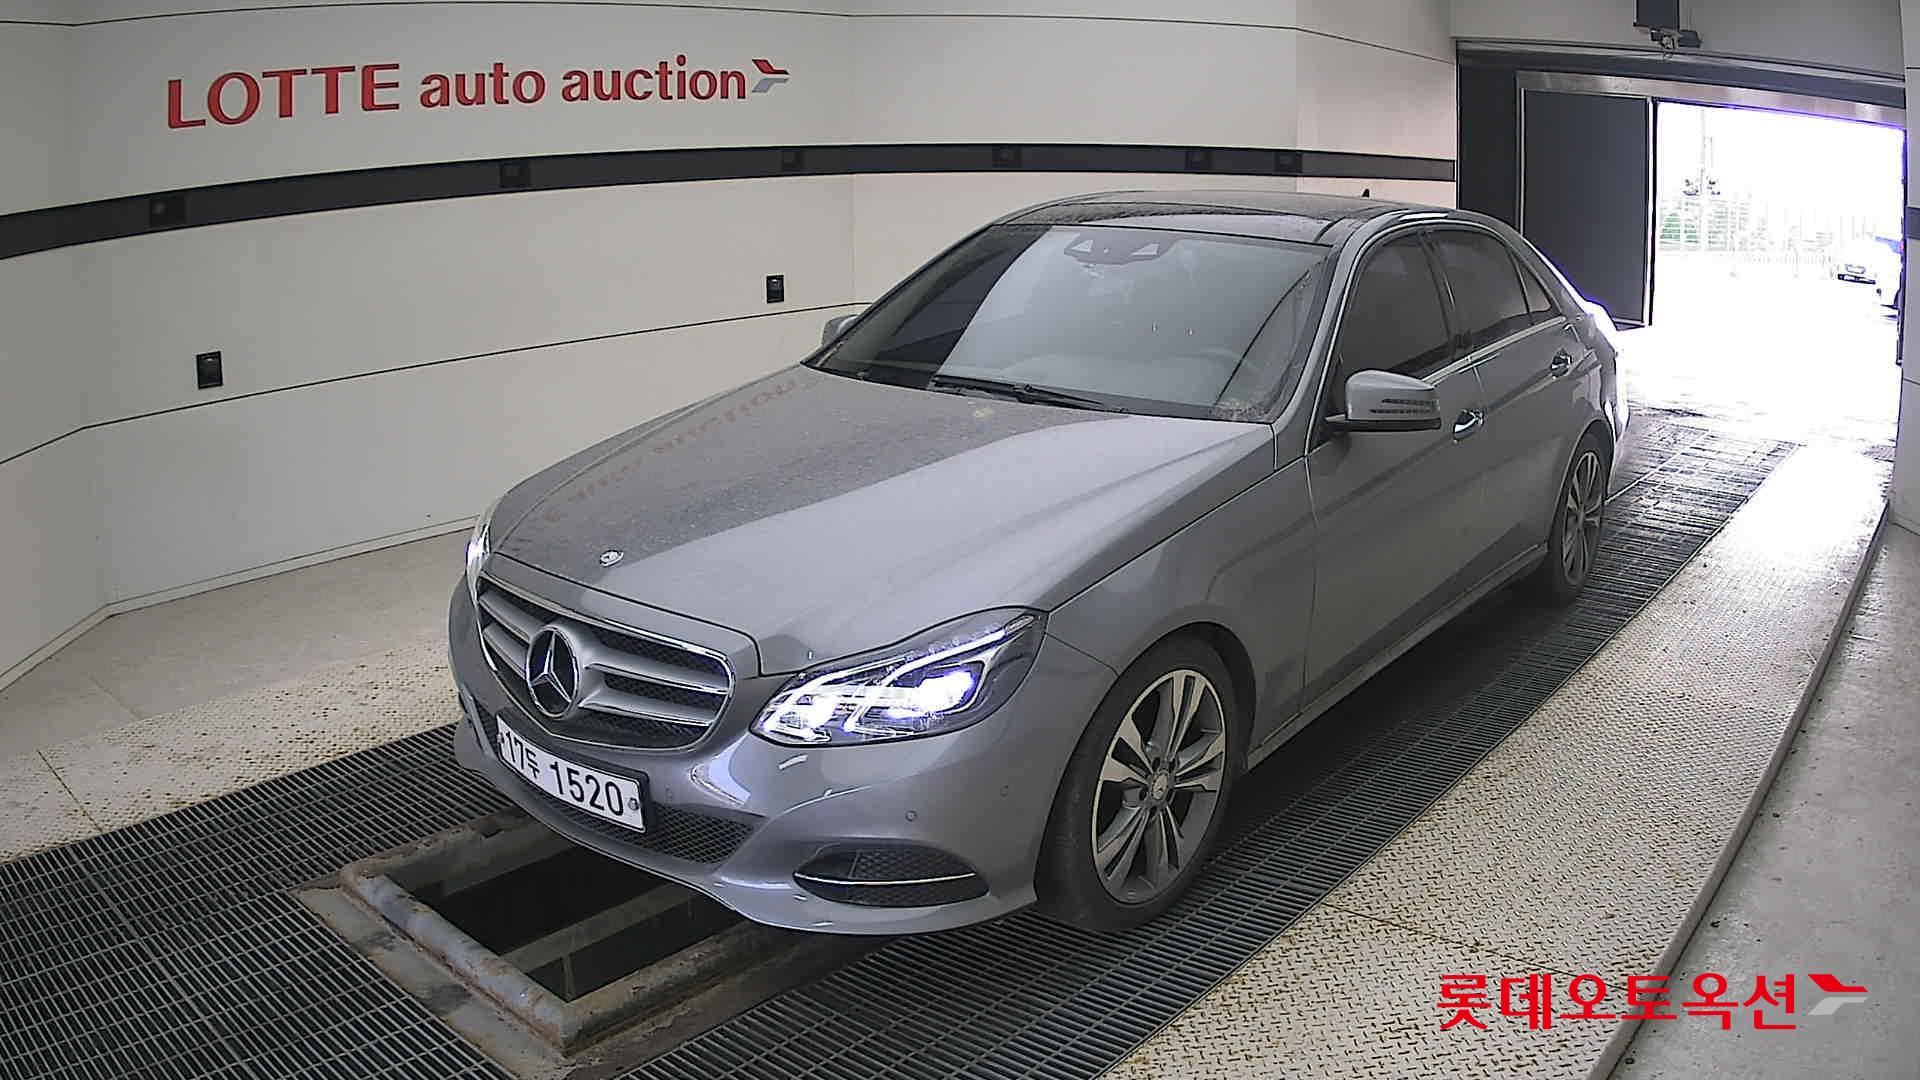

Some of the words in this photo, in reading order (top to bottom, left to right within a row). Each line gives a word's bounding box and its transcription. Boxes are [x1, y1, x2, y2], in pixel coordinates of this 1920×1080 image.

[167, 63, 400, 129] LOTTE
[419, 62, 546, 108] auto
[561, 54, 747, 102] auction
[506, 731, 541, 779] 17두
[550, 761, 624, 816] 1520
